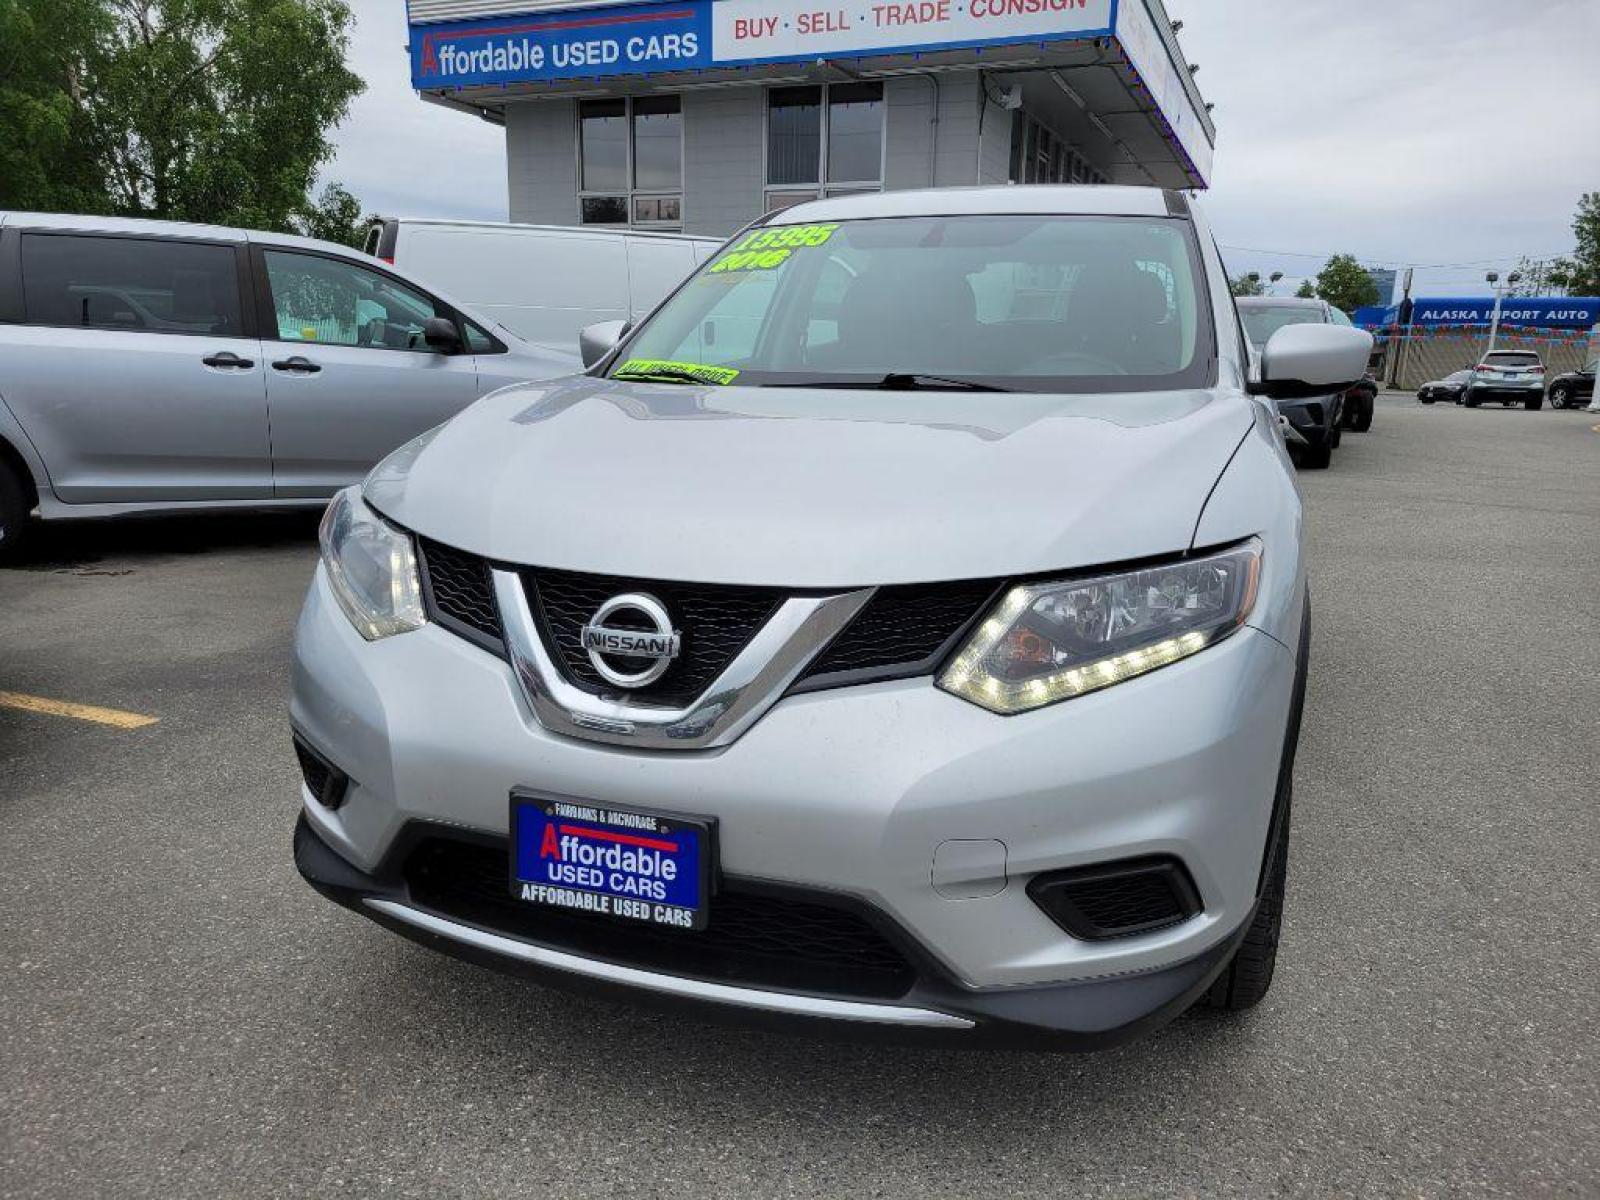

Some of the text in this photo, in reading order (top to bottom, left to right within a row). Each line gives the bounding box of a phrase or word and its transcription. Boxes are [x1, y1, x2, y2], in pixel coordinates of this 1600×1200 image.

[734, 16, 778, 40] BUY
[798, 11, 851, 35] SELL
[872, 0, 950, 28] TRADE
[421, 32, 698, 76] Affordable USED CARS
[733, 223, 839, 249] 15995
[709, 249, 791, 272] 2016
[1421, 310, 1479, 320] ALASKA
[1545, 310, 1589, 320] AUTO
[588, 632, 666, 654] NISSAN
[599, 810, 606, 823] &
[539, 823, 678, 880] Affordable
[549, 863, 667, 900] USED CARS
[521, 884, 693, 928] AFFORDABLE USED CARS
